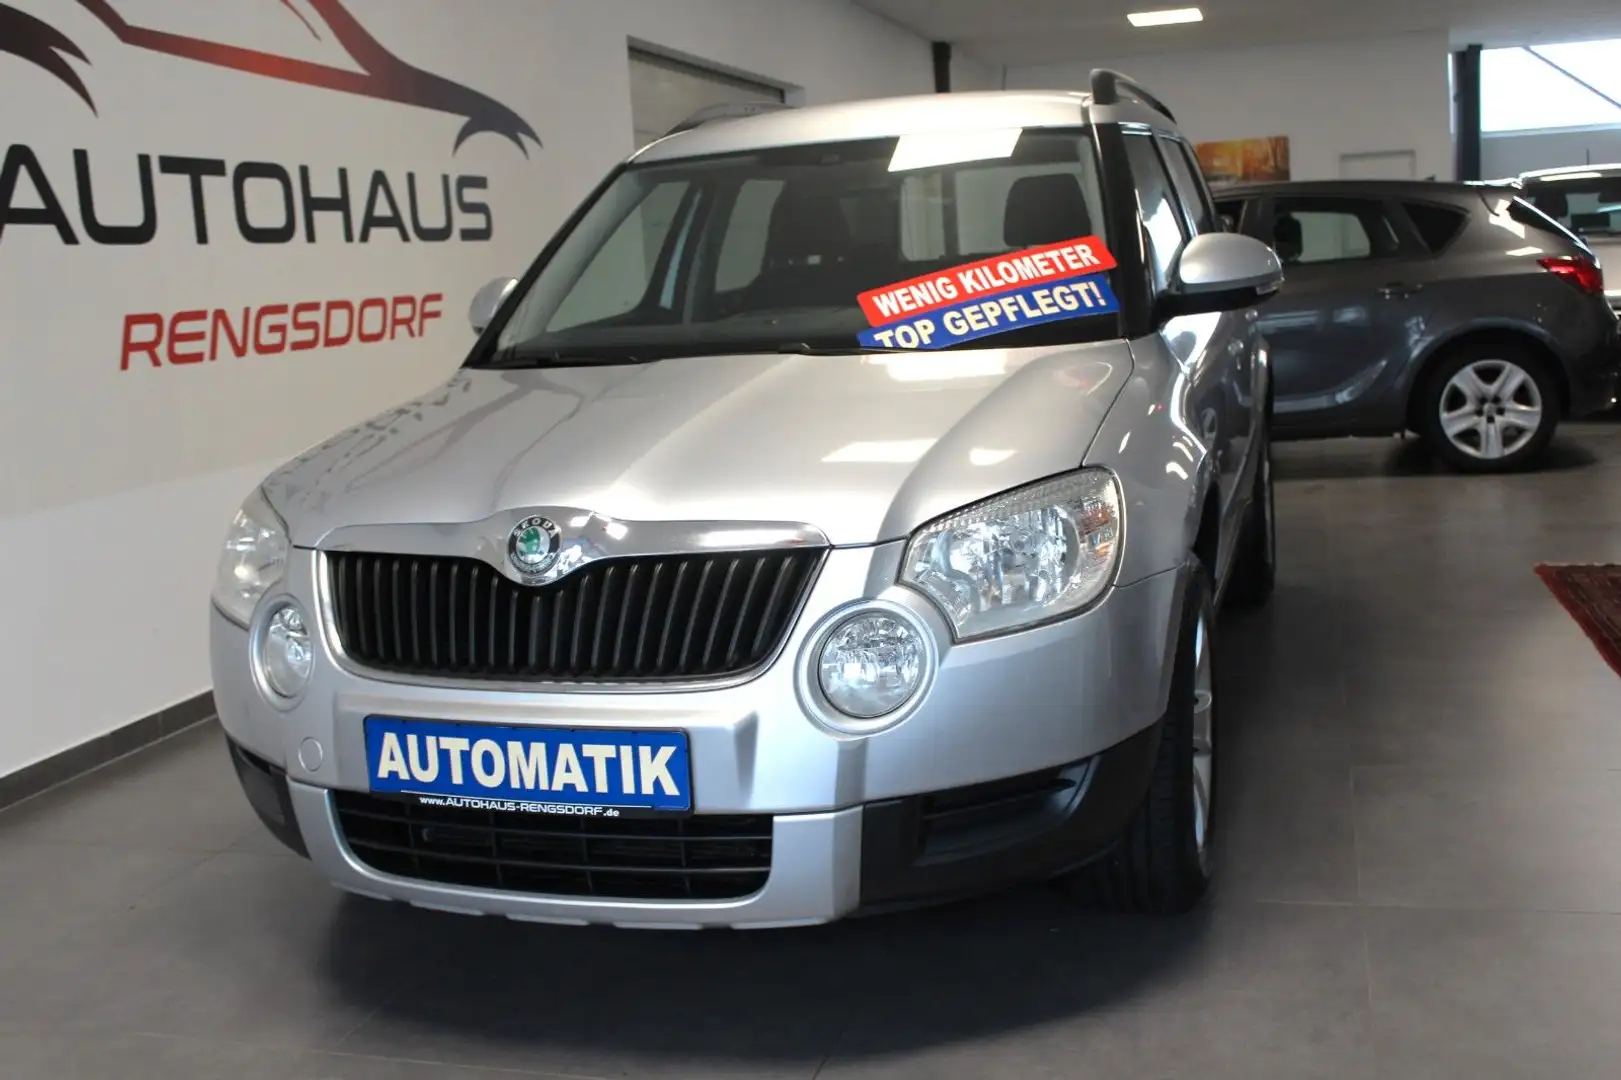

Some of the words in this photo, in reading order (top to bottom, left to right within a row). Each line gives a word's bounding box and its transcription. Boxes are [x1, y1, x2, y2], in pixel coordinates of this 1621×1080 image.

[0, 143, 493, 246] AUTOHAUS
[872, 276, 958, 318] WENIG
[958, 243, 1100, 294] KILOMETER
[873, 318, 936, 350] TOP
[943, 281, 1106, 336] GEPFLEGT!
[119, 293, 443, 371] RENGSDORF
[376, 731, 681, 797] AUTOMATIK
[419, 796, 620, 817] www.AUTOHAUS-RENGSDORF.de
